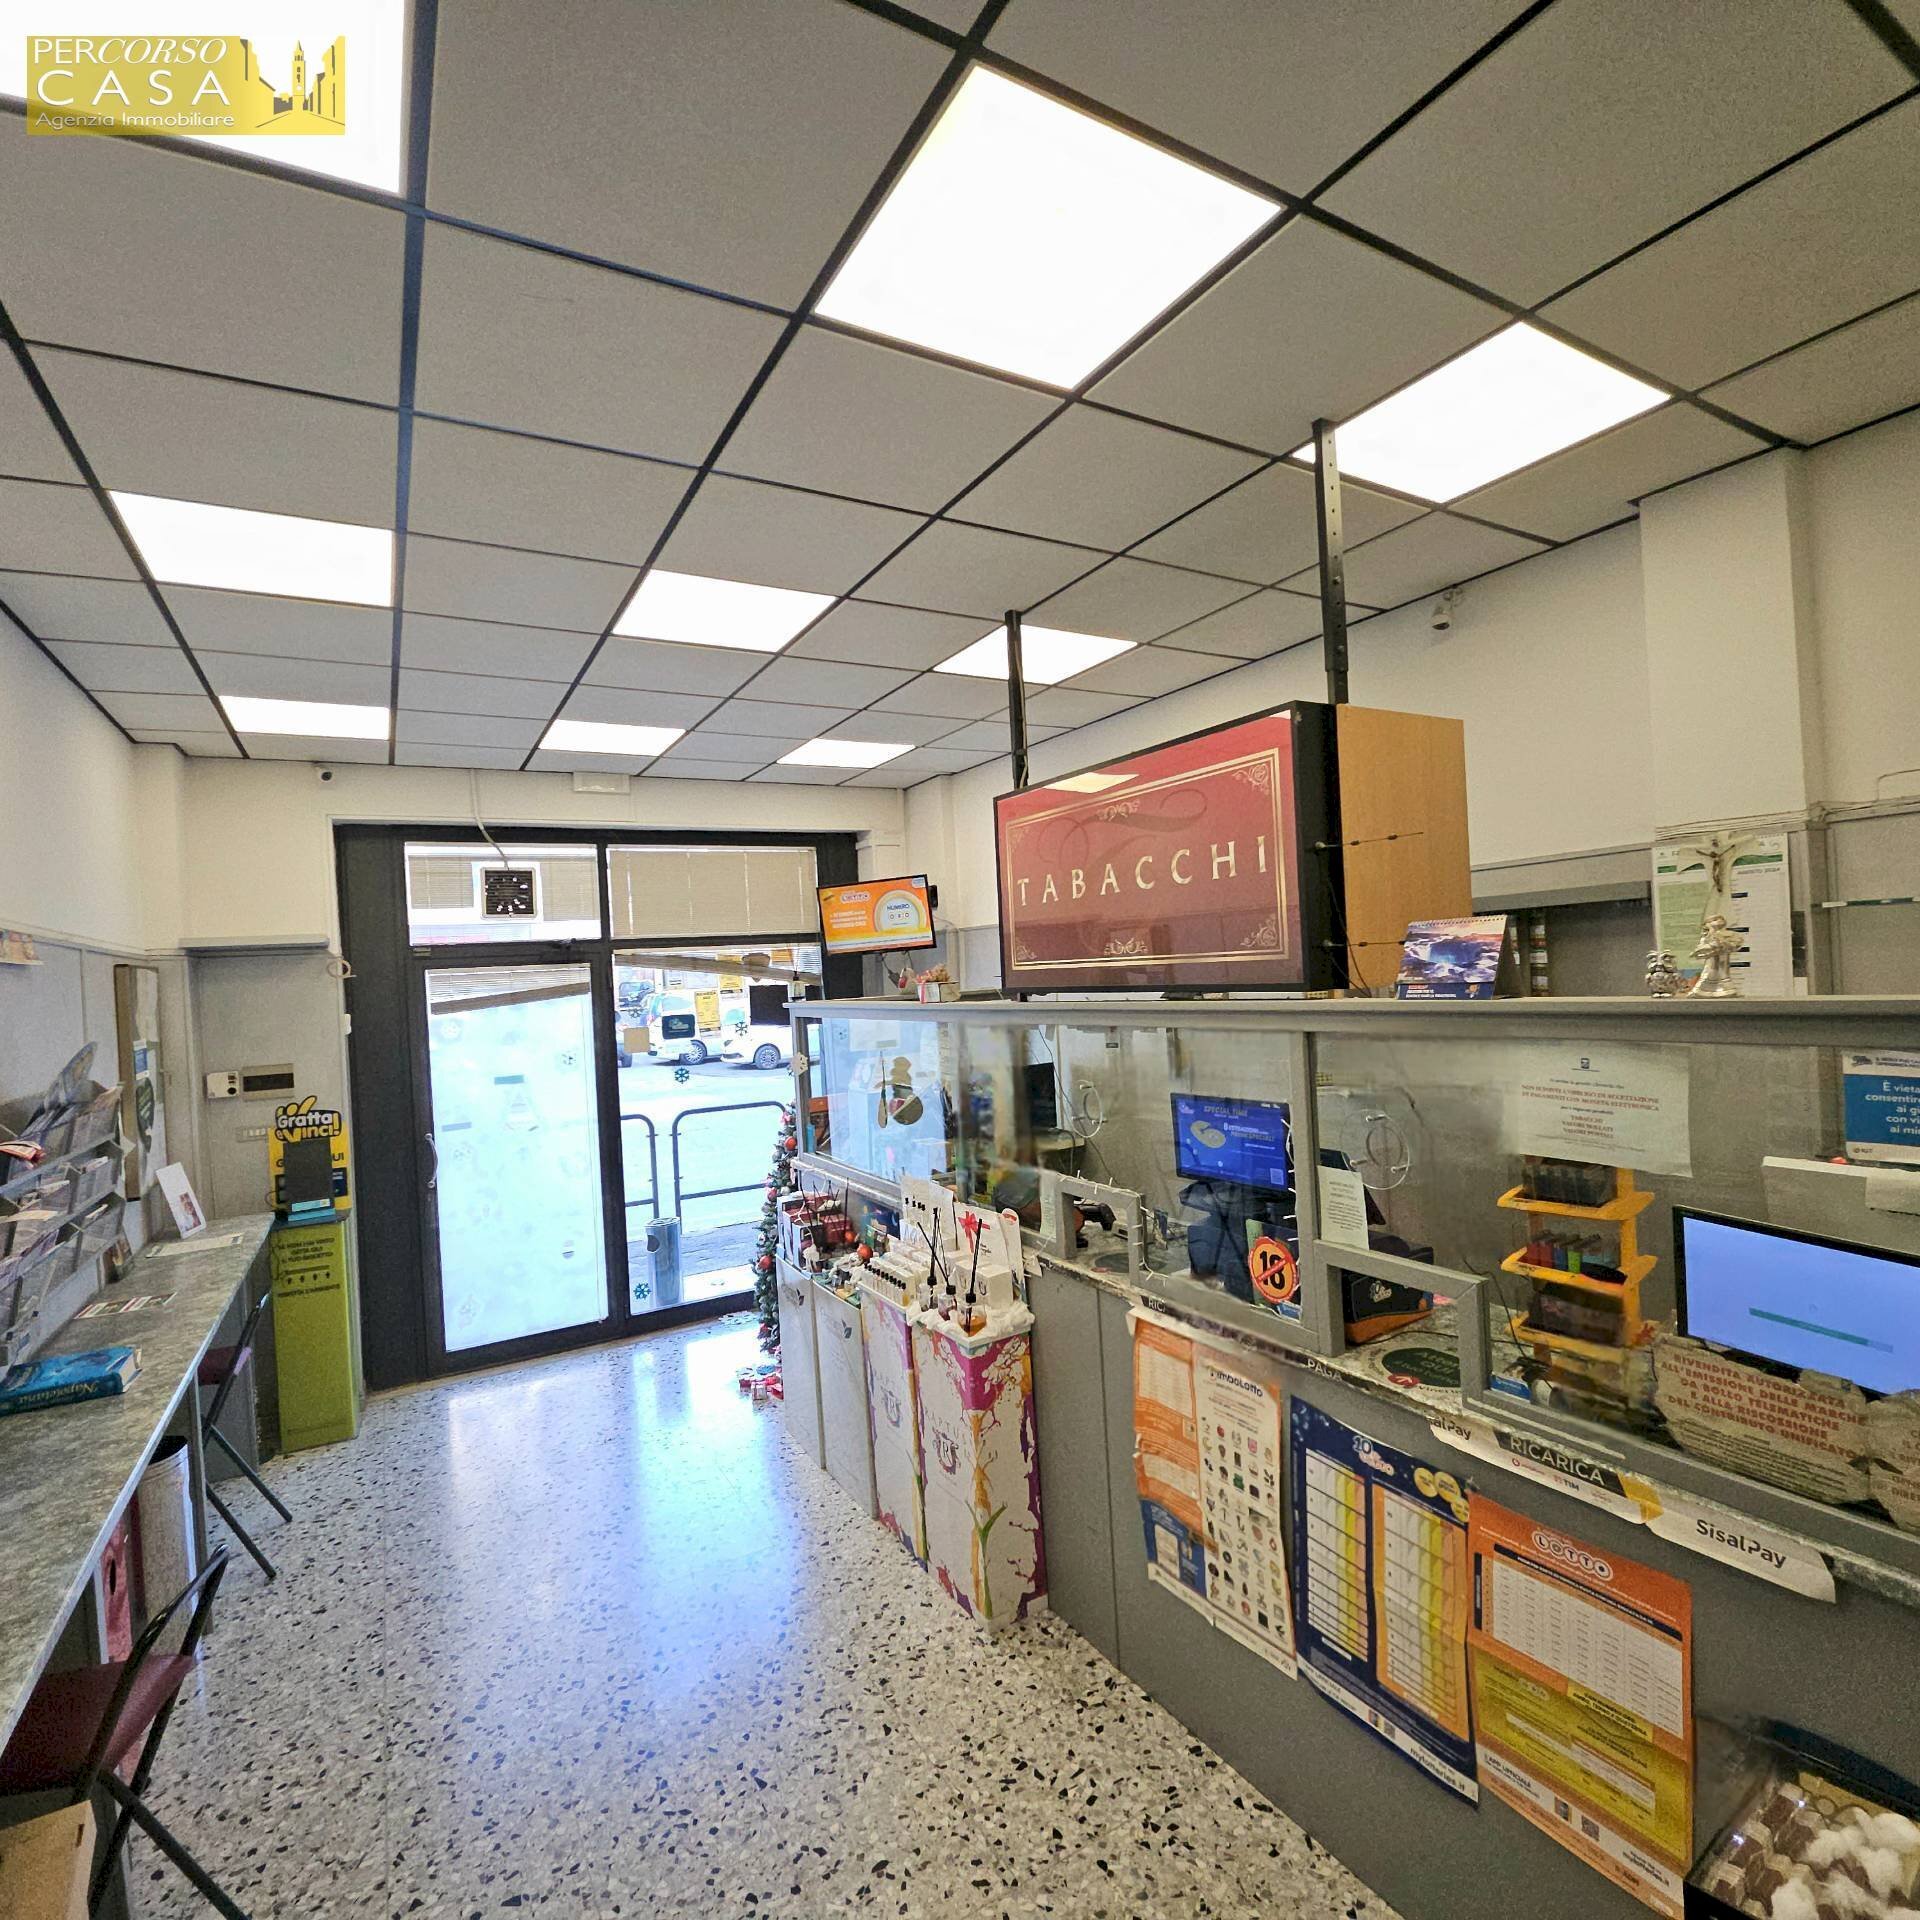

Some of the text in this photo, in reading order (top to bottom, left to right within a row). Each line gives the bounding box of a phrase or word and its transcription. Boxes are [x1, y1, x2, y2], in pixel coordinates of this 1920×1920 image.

[1016, 835, 1269, 907] TABACCHI
[1882, 1079, 1891, 1092] È
[278, 1110, 333, 1129] Gratta
[1896, 1104, 1907, 1113] ai
[332, 1152, 344, 1162] UI
[1259, 1250, 1286, 1290] 18
[1148, 1297, 1166, 1312] RIC
[1307, 1358, 1343, 1382] PAGA
[1673, 1353, 1741, 1379] RIVENDITA
[1668, 1395, 1690, 1408] DEL
[1694, 1402, 1776, 1434] CONTRIBUTO
[1681, 1378, 1840, 1431] DA BOLLO TELEMATICHE
[1702, 1394, 1733, 1410] ALLA
[1737, 1405, 1828, 1440] RISCOSSIONE
[1759, 1389, 1798, 1408] DELLE
[1804, 1403, 1867, 1426] MARCHE
[1509, 1436, 1606, 1487] RICARICA
[1532, 1530, 1613, 1581] LOTTO
[1696, 1518, 1786, 1569] SisalPay
